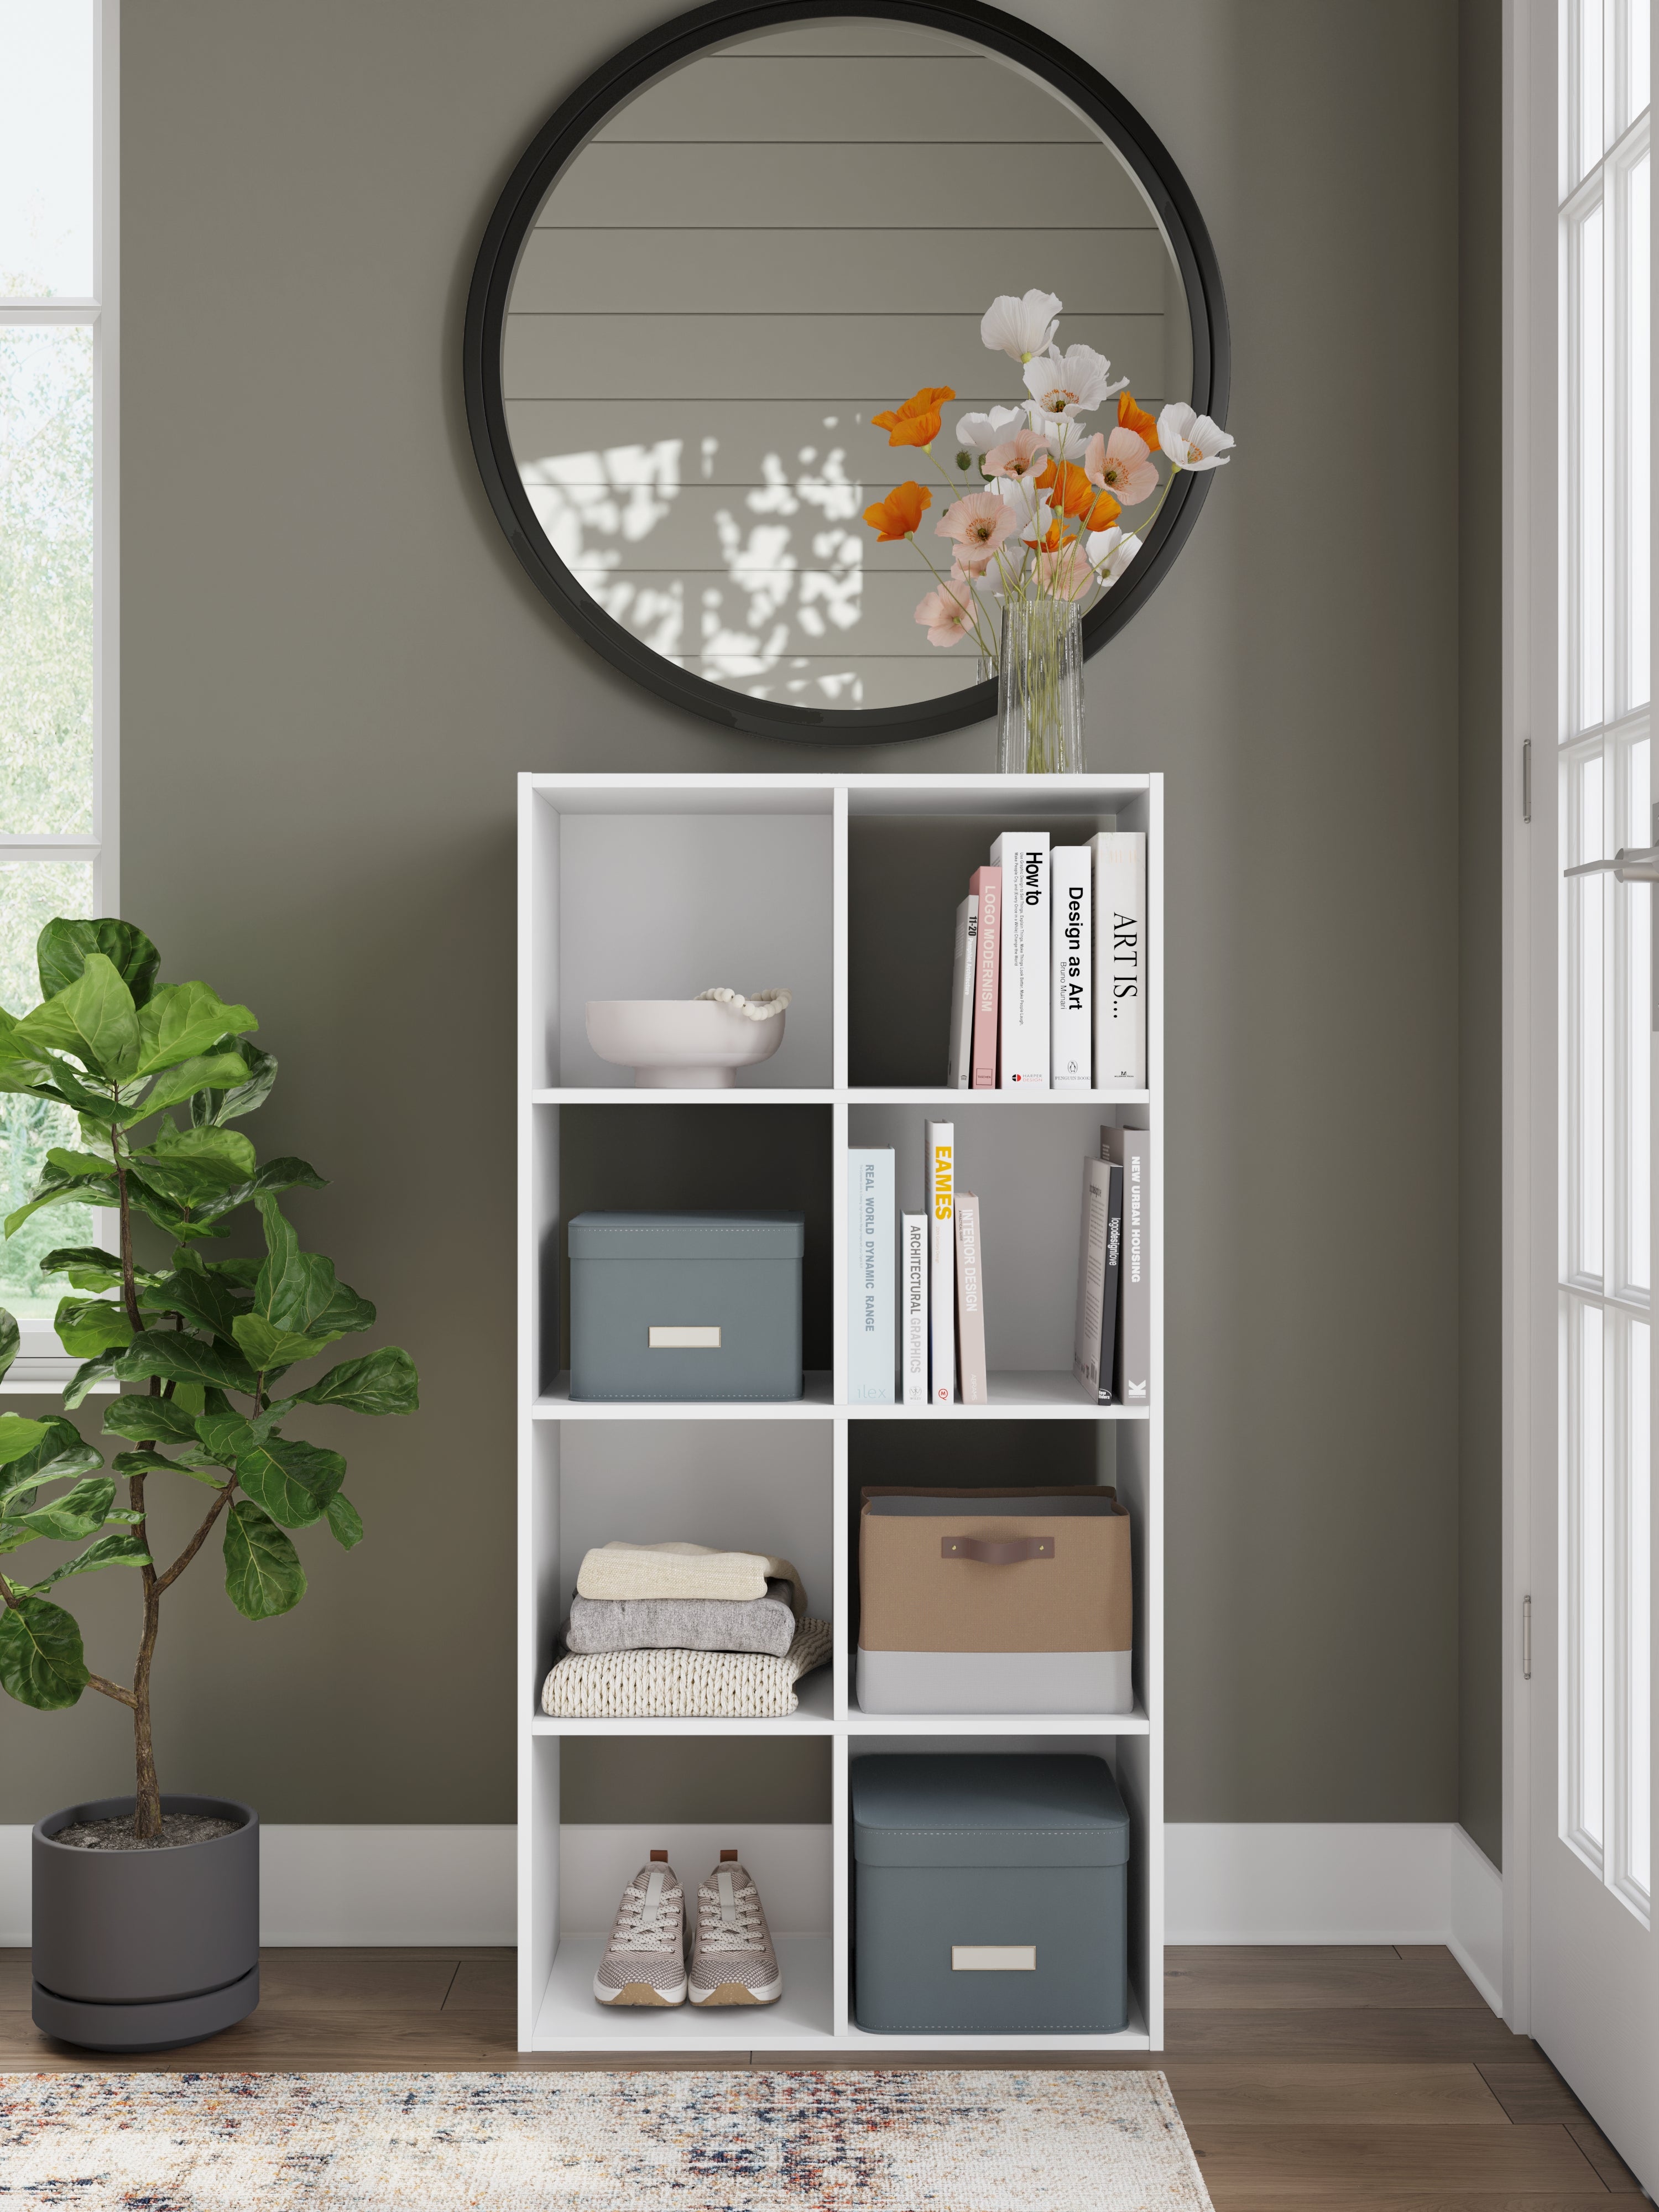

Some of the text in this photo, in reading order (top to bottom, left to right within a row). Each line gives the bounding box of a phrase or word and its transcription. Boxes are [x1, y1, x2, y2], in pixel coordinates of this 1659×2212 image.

[1026, 853, 1042, 905] How to
[968, 916, 977, 936] 11-20
[982, 885, 995, 1011] LOGO MODERNISM
[1065, 888, 1083, 1009] Design as Art
[1114, 912, 1138, 1018] ART IS...
[936, 1146, 951, 1220] EAMES
[1131, 1186, 1140, 1225] URBAN
[963, 1209, 977, 1311] INTERIOR DESIGN
[1108, 1218, 1121, 1265] logodesignlove
[1131, 1229, 1140, 1282] HOUSING
[910, 1225, 921, 1374] ARCHITECTURAL GRAPHICS
[858, 1385, 886, 1399] ilex
